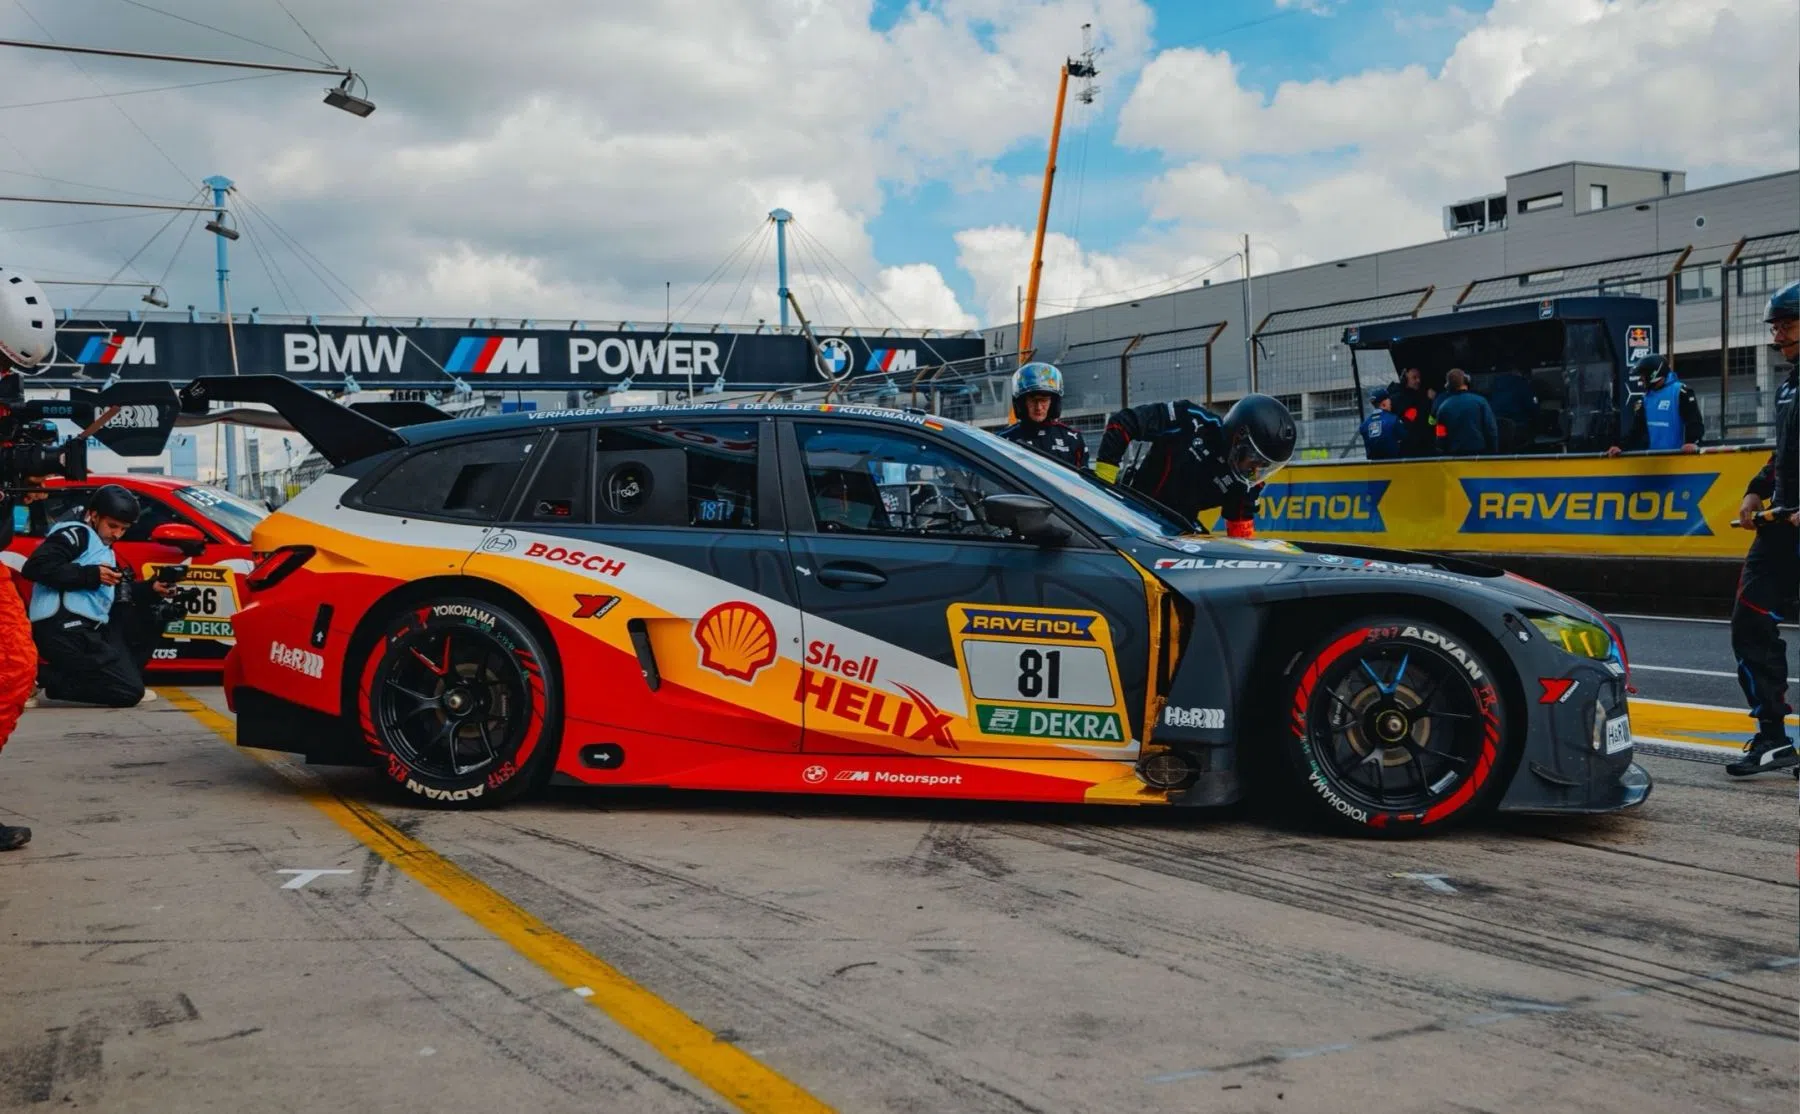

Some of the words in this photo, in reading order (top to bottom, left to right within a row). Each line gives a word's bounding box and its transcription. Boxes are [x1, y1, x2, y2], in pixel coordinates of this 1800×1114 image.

[283, 333, 408, 373] BMW
[570, 338, 719, 375] POWER
[528, 407, 606, 420] VERHAGEN
[628, 405, 647, 413] DE
[650, 403, 719, 412] PHILLIPPI
[767, 403, 814, 411] WILDE
[838, 406, 926, 425] KLINGMANN
[1257, 494, 1371, 521] VENOL
[525, 543, 627, 578] BOSCH
[1153, 558, 1284, 570] FALKEN
[175, 586, 217, 614] 66
[190, 621, 235, 636] DEKR
[433, 604, 497, 628] YOKOHAMA
[971, 615, 1085, 636] RAVENOL
[806, 639, 879, 683] Shell
[1400, 626, 1484, 681] ADVAN
[1017, 648, 1061, 699] 81
[791, 666, 960, 751] HELIX
[1029, 711, 1120, 740] DEKRA
[406, 778, 485, 801] ADVAN
[875, 771, 963, 786] Motorsport
[1308, 770, 1368, 824] YOKOHAMA
